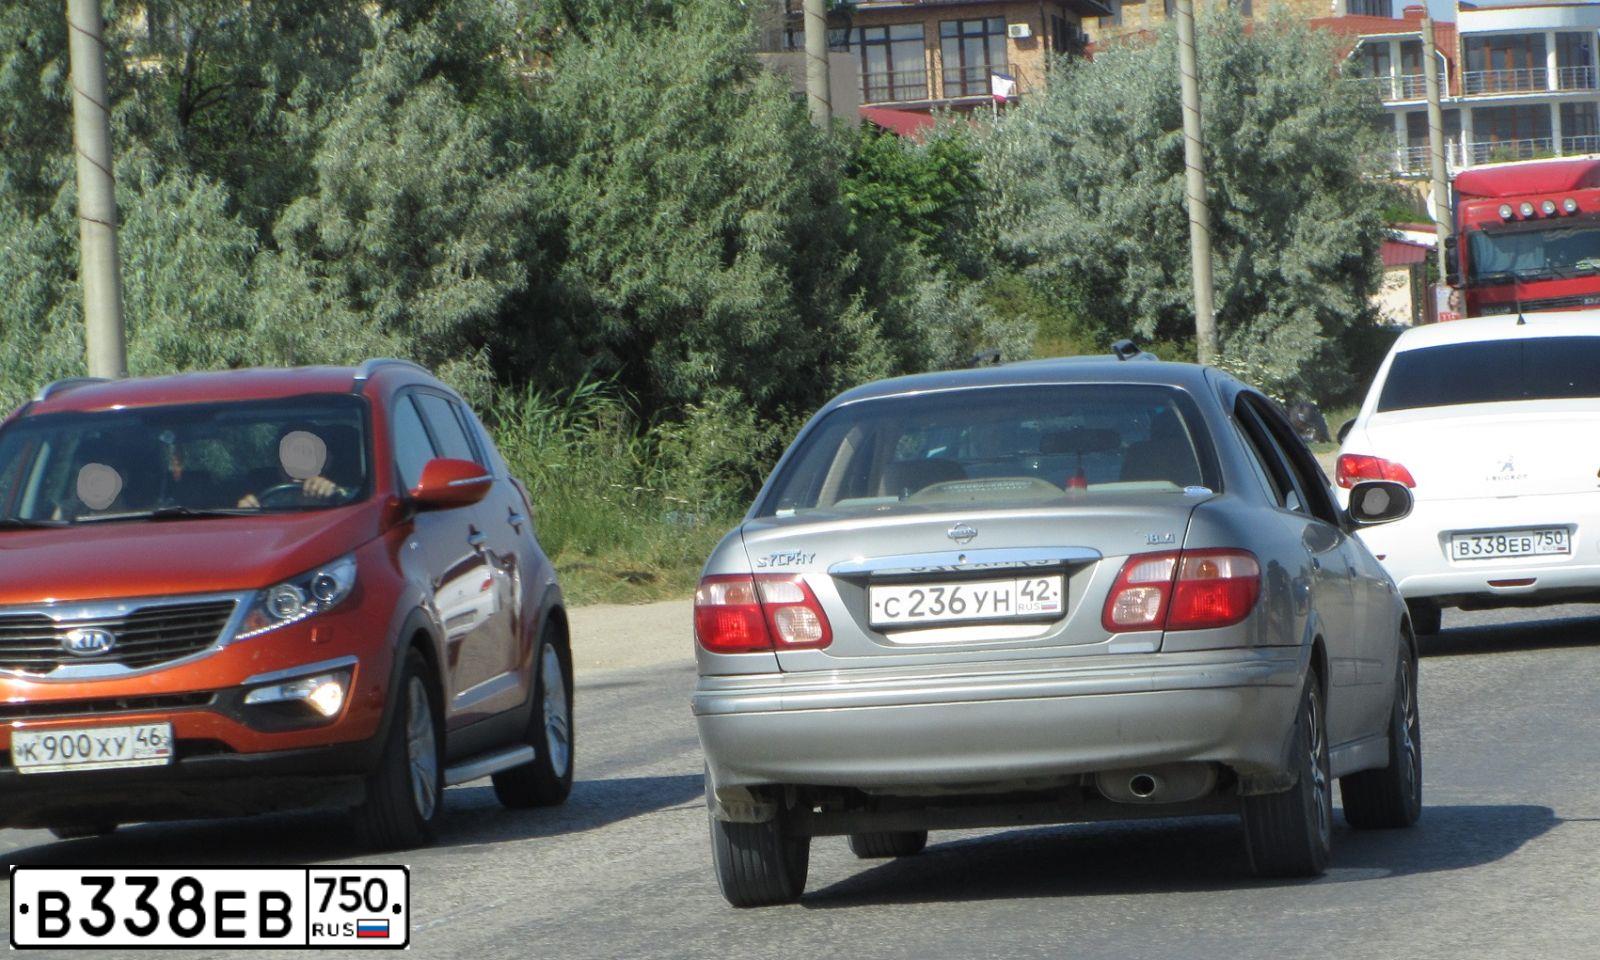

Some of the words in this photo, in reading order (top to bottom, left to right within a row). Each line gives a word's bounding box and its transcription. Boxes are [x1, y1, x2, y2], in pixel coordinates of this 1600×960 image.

[1460, 535, 1532, 555] В338ЕВ
[1535, 530, 1563, 545] 750
[884, 587, 1009, 618] С236УН
[1020, 580, 1050, 601] 42
[1018, 602, 1040, 611] RUS
[24, 734, 127, 761] К900ХУ
[136, 728, 161, 746] 46
